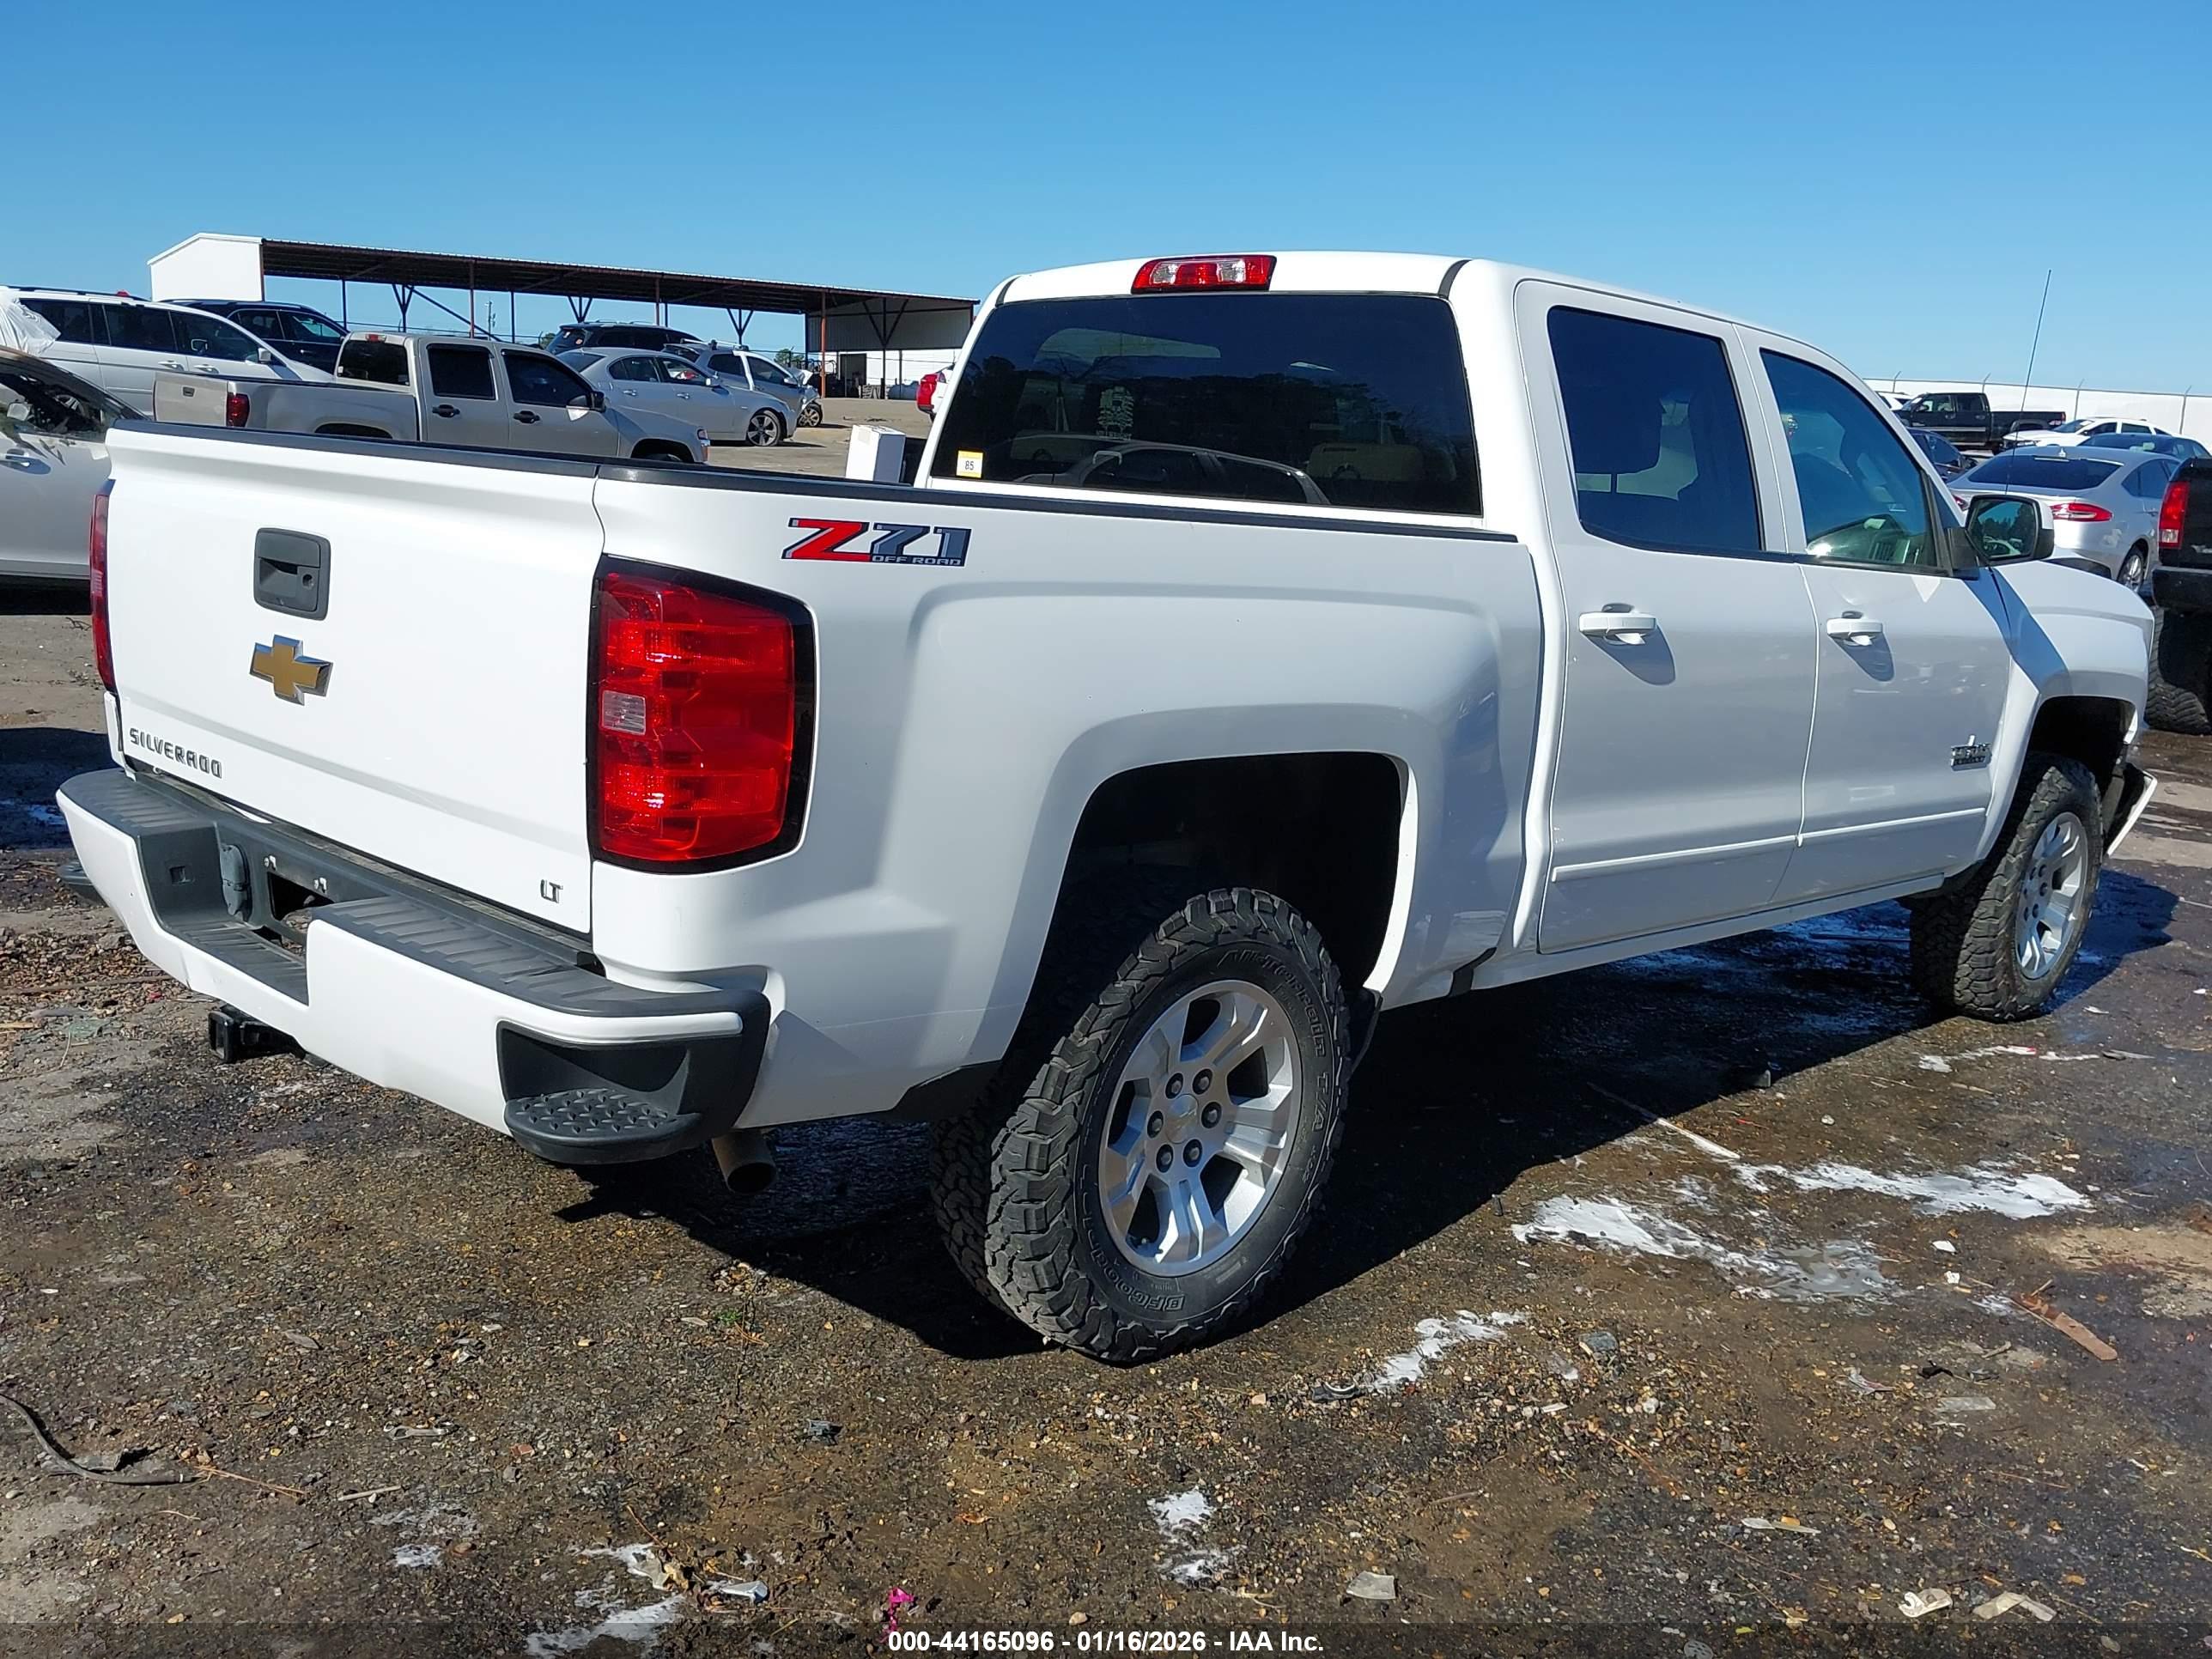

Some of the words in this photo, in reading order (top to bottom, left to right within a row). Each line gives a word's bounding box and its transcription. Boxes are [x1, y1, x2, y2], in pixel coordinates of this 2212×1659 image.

[964, 459, 975, 471] 85
[781, 517, 972, 564] Z71
[872, 555, 908, 563] OFF
[912, 556, 962, 567] ROAD
[129, 727, 222, 779] SILVERADO
[539, 878, 564, 904] LT
